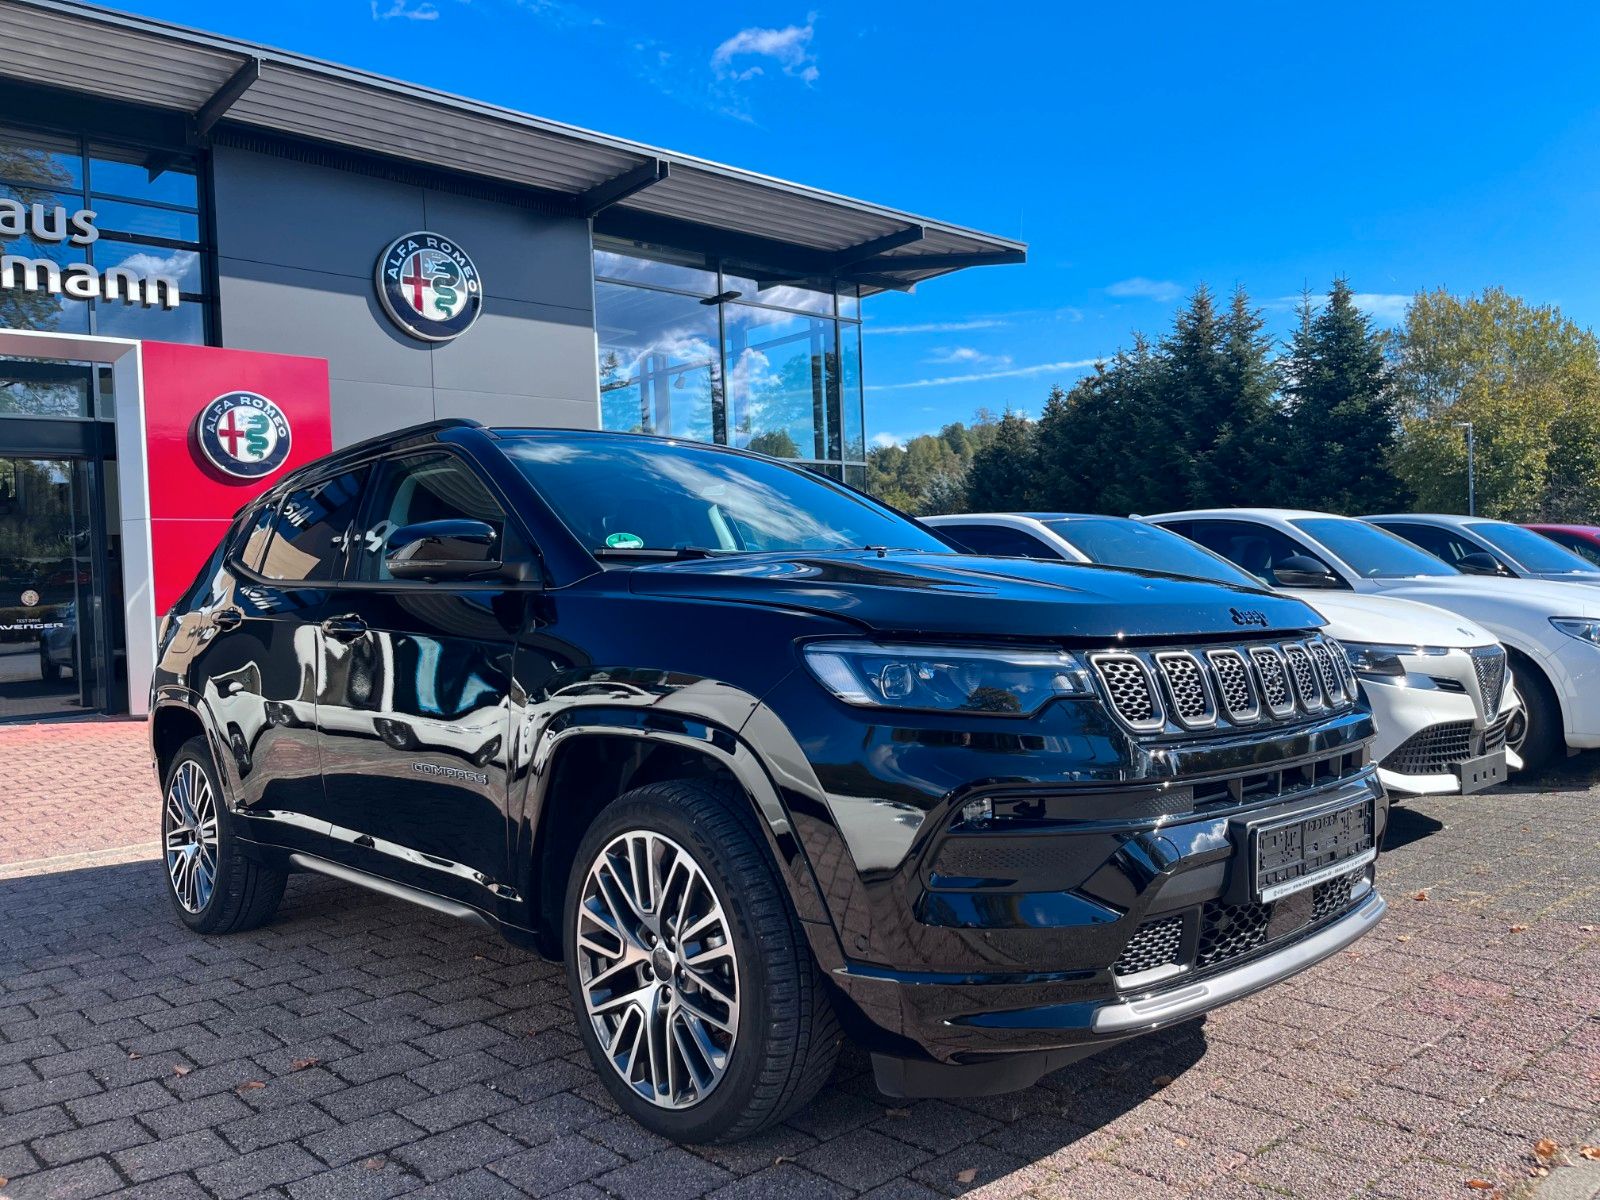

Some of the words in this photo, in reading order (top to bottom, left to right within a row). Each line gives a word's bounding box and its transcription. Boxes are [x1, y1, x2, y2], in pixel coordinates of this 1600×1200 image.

[0, 199, 99, 244] aus
[1, 255, 179, 307] mann
[388, 240, 419, 280] ALFA
[426, 237, 478, 292] ROMEO
[206, 400, 233, 433] ALFA
[240, 396, 286, 438] ROMEO
[1229, 607, 1269, 628] Jeep
[412, 762, 489, 785] COMPASS
